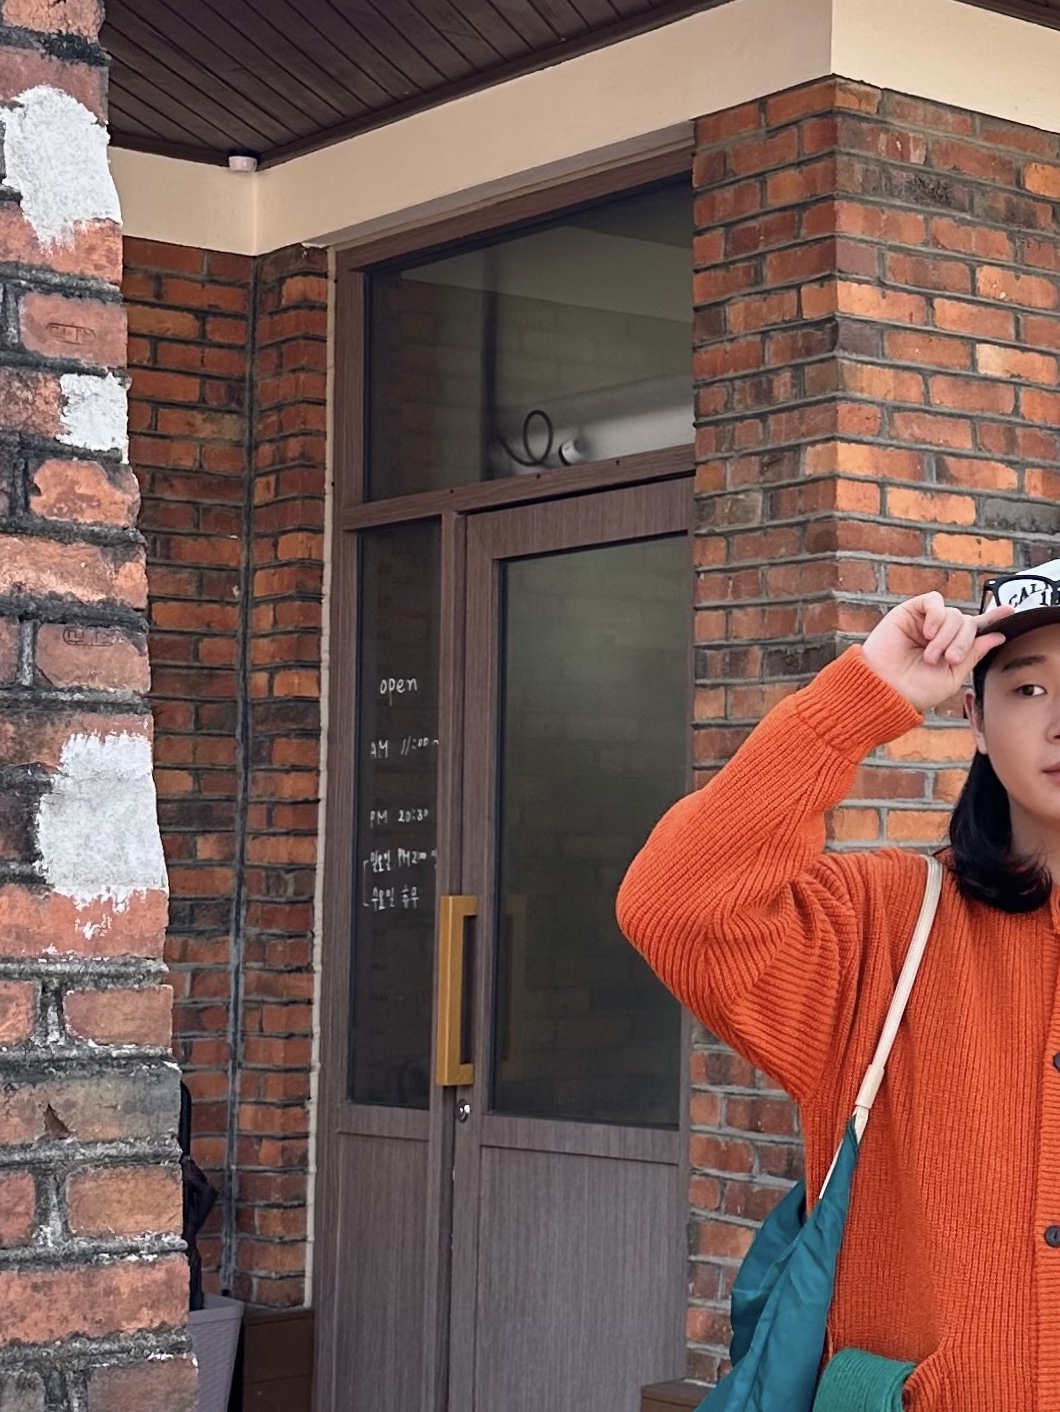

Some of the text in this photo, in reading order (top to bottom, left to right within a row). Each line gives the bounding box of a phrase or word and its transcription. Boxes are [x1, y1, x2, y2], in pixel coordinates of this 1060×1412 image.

[379, 677, 418, 707] open
[370, 739, 389, 758] AM
[370, 808, 429, 829] PM 20:30
